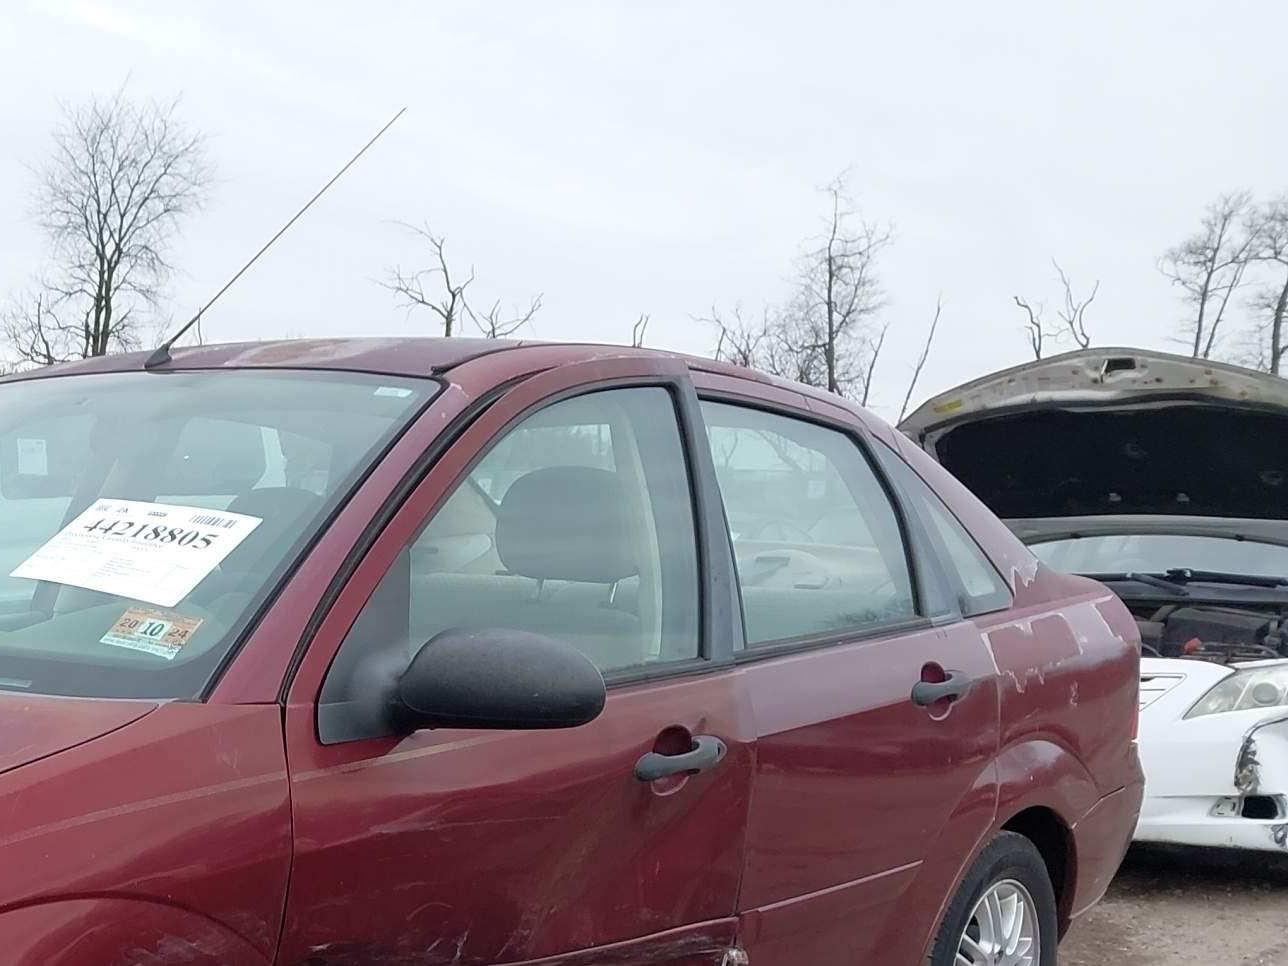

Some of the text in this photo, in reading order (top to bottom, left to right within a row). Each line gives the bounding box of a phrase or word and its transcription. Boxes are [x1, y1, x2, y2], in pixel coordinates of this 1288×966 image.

[83, 517, 220, 549] 44218805
[119, 618, 189, 639] 20 10 24
